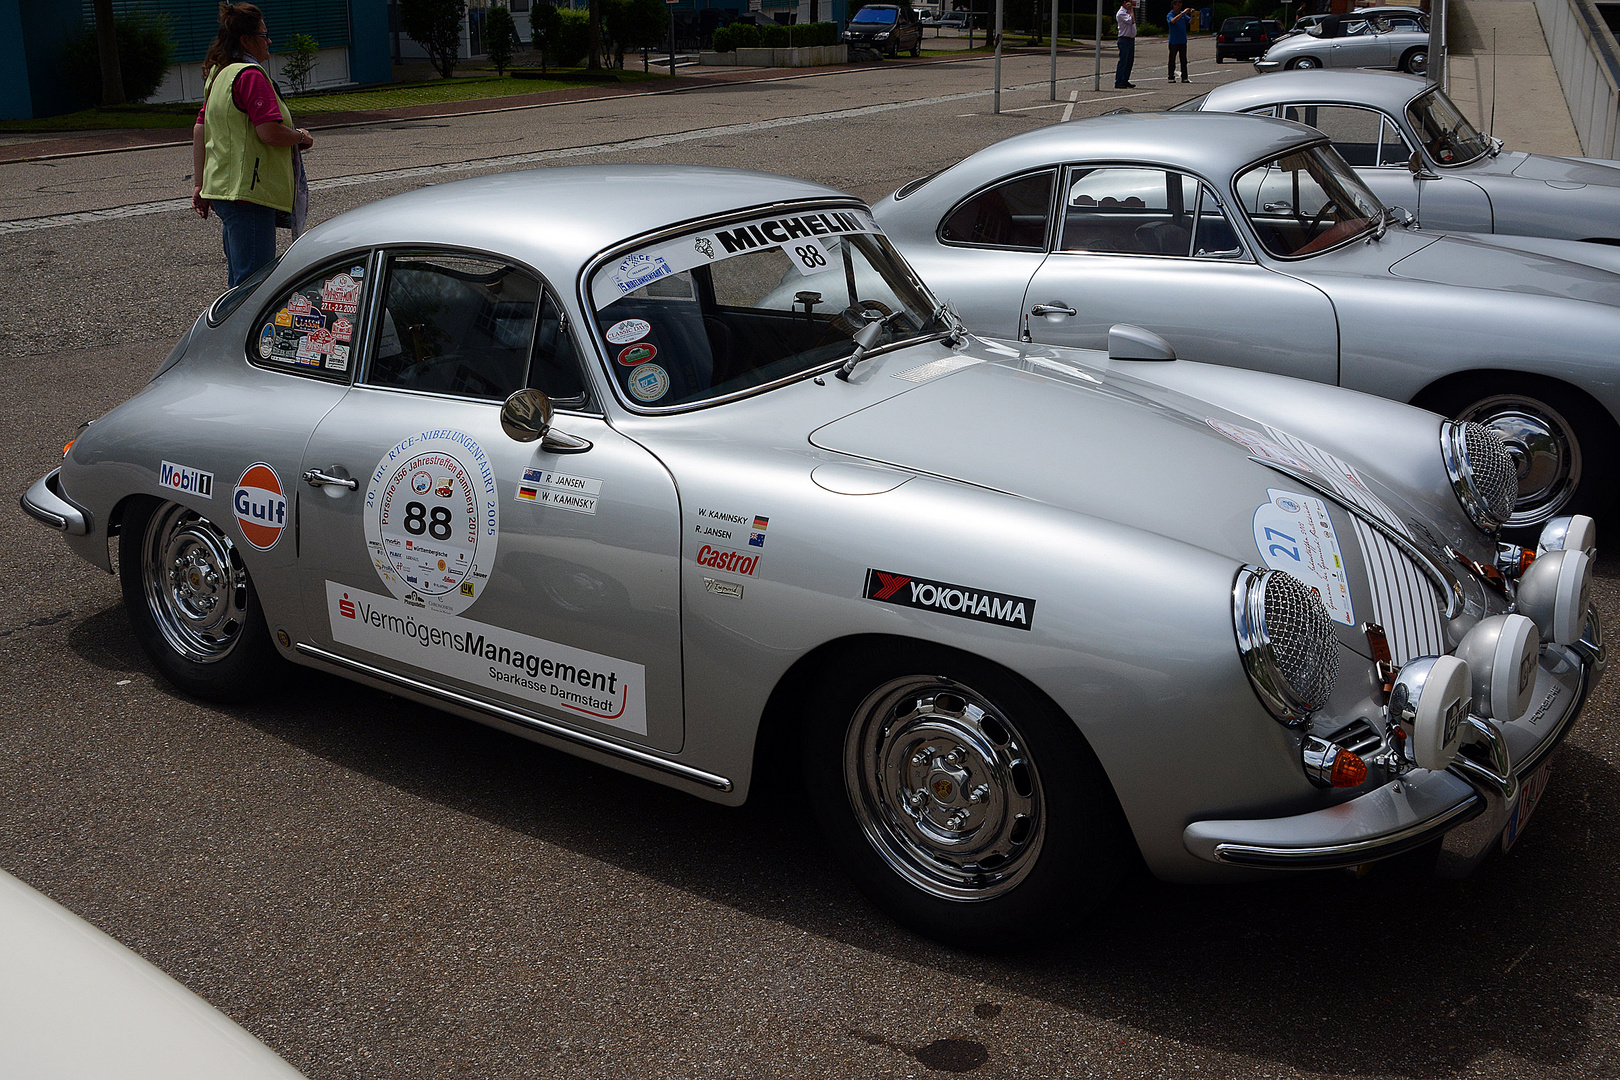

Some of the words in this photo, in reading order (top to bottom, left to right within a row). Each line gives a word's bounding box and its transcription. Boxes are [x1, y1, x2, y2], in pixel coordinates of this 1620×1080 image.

[715, 212, 866, 254] MICHELIN
[794, 244, 827, 269] 88
[161, 464, 198, 492] Mobil
[201, 475, 208, 494] 1
[545, 474, 552, 484] R.
[555, 475, 586, 489] JANSEN
[234, 489, 286, 525] Gulf
[372, 464, 388, 484] Int.
[487, 501, 496, 536] 2005
[382, 484, 396, 525] Porsche
[393, 468, 408, 486] 356
[408, 455, 458, 475] Jahrestreffen
[455, 469, 475, 514] Bamberg
[467, 516, 477, 544] 2015
[542, 491, 551, 502] W.
[553, 493, 594, 510] KAMINSKY
[698, 507, 706, 517] W.
[708, 509, 748, 525] KAMINSKY
[403, 501, 453, 541] 88
[694, 524, 701, 534] R.
[703, 526, 732, 540] JANSEN
[696, 544, 760, 576] Castrol
[1263, 526, 1301, 562] 27
[910, 581, 1027, 625] YOKOHAMA
[357, 600, 618, 695] VermögensManagement
[488, 666, 548, 694] Sparkasse
[549, 683, 614, 713] Darmstadt
[1528, 684, 1561, 726] PORSCHE
